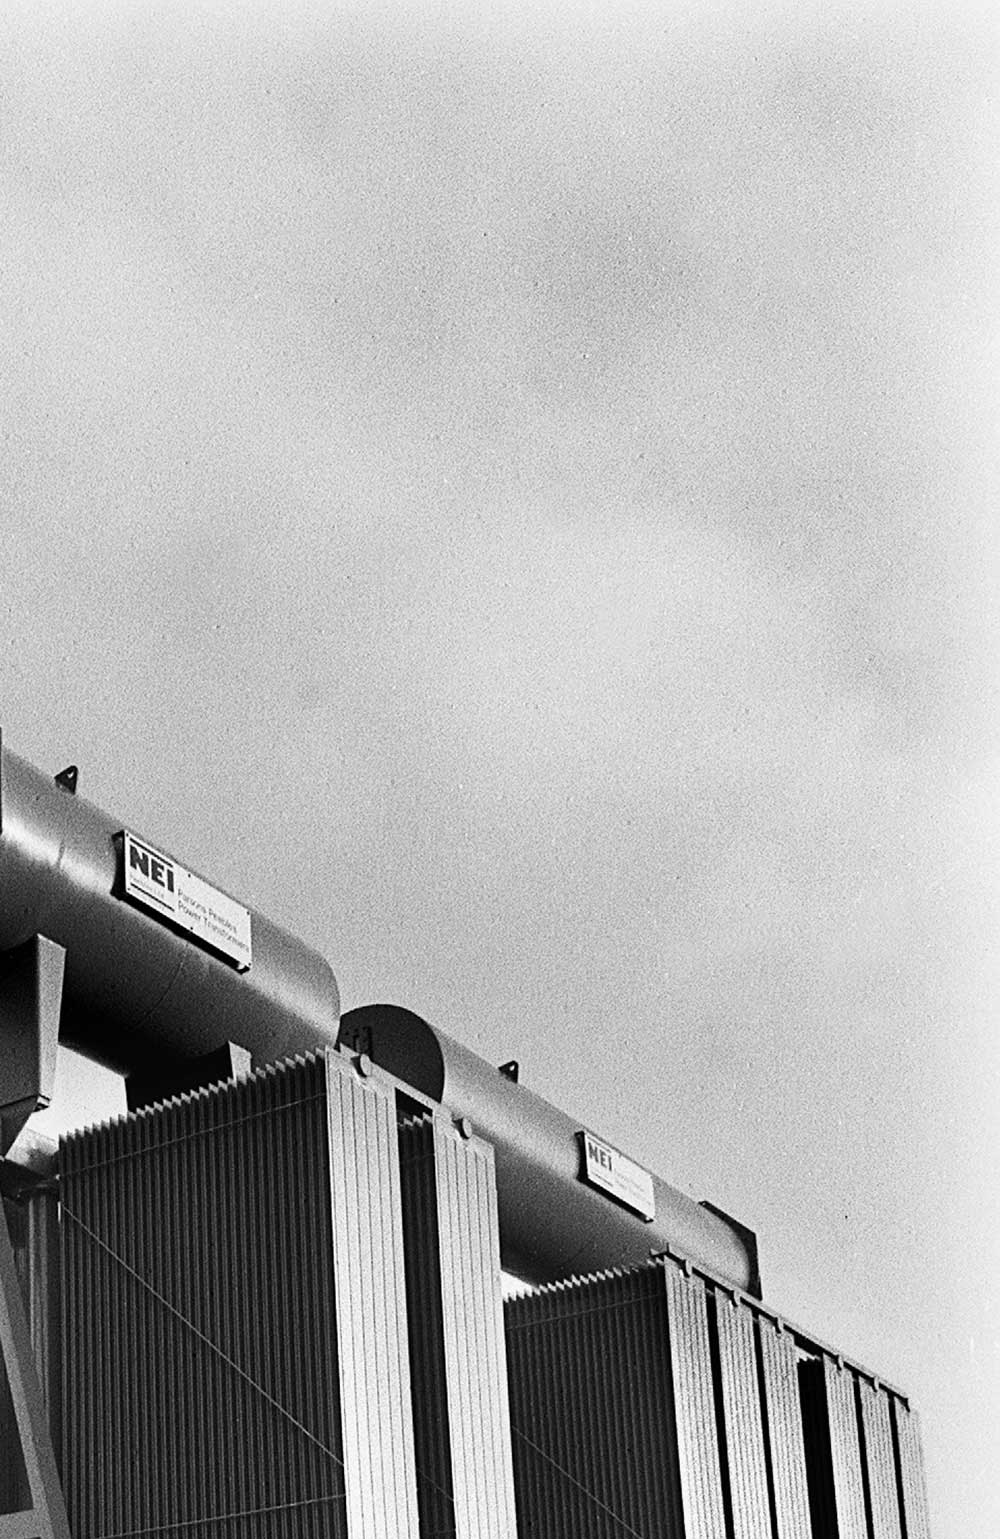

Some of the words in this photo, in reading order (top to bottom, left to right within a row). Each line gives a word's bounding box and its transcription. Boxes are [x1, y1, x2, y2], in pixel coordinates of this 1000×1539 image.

[129, 844, 174, 893] NEI
[178, 899, 202, 920] Power
[588, 1142, 612, 1171] NEI
